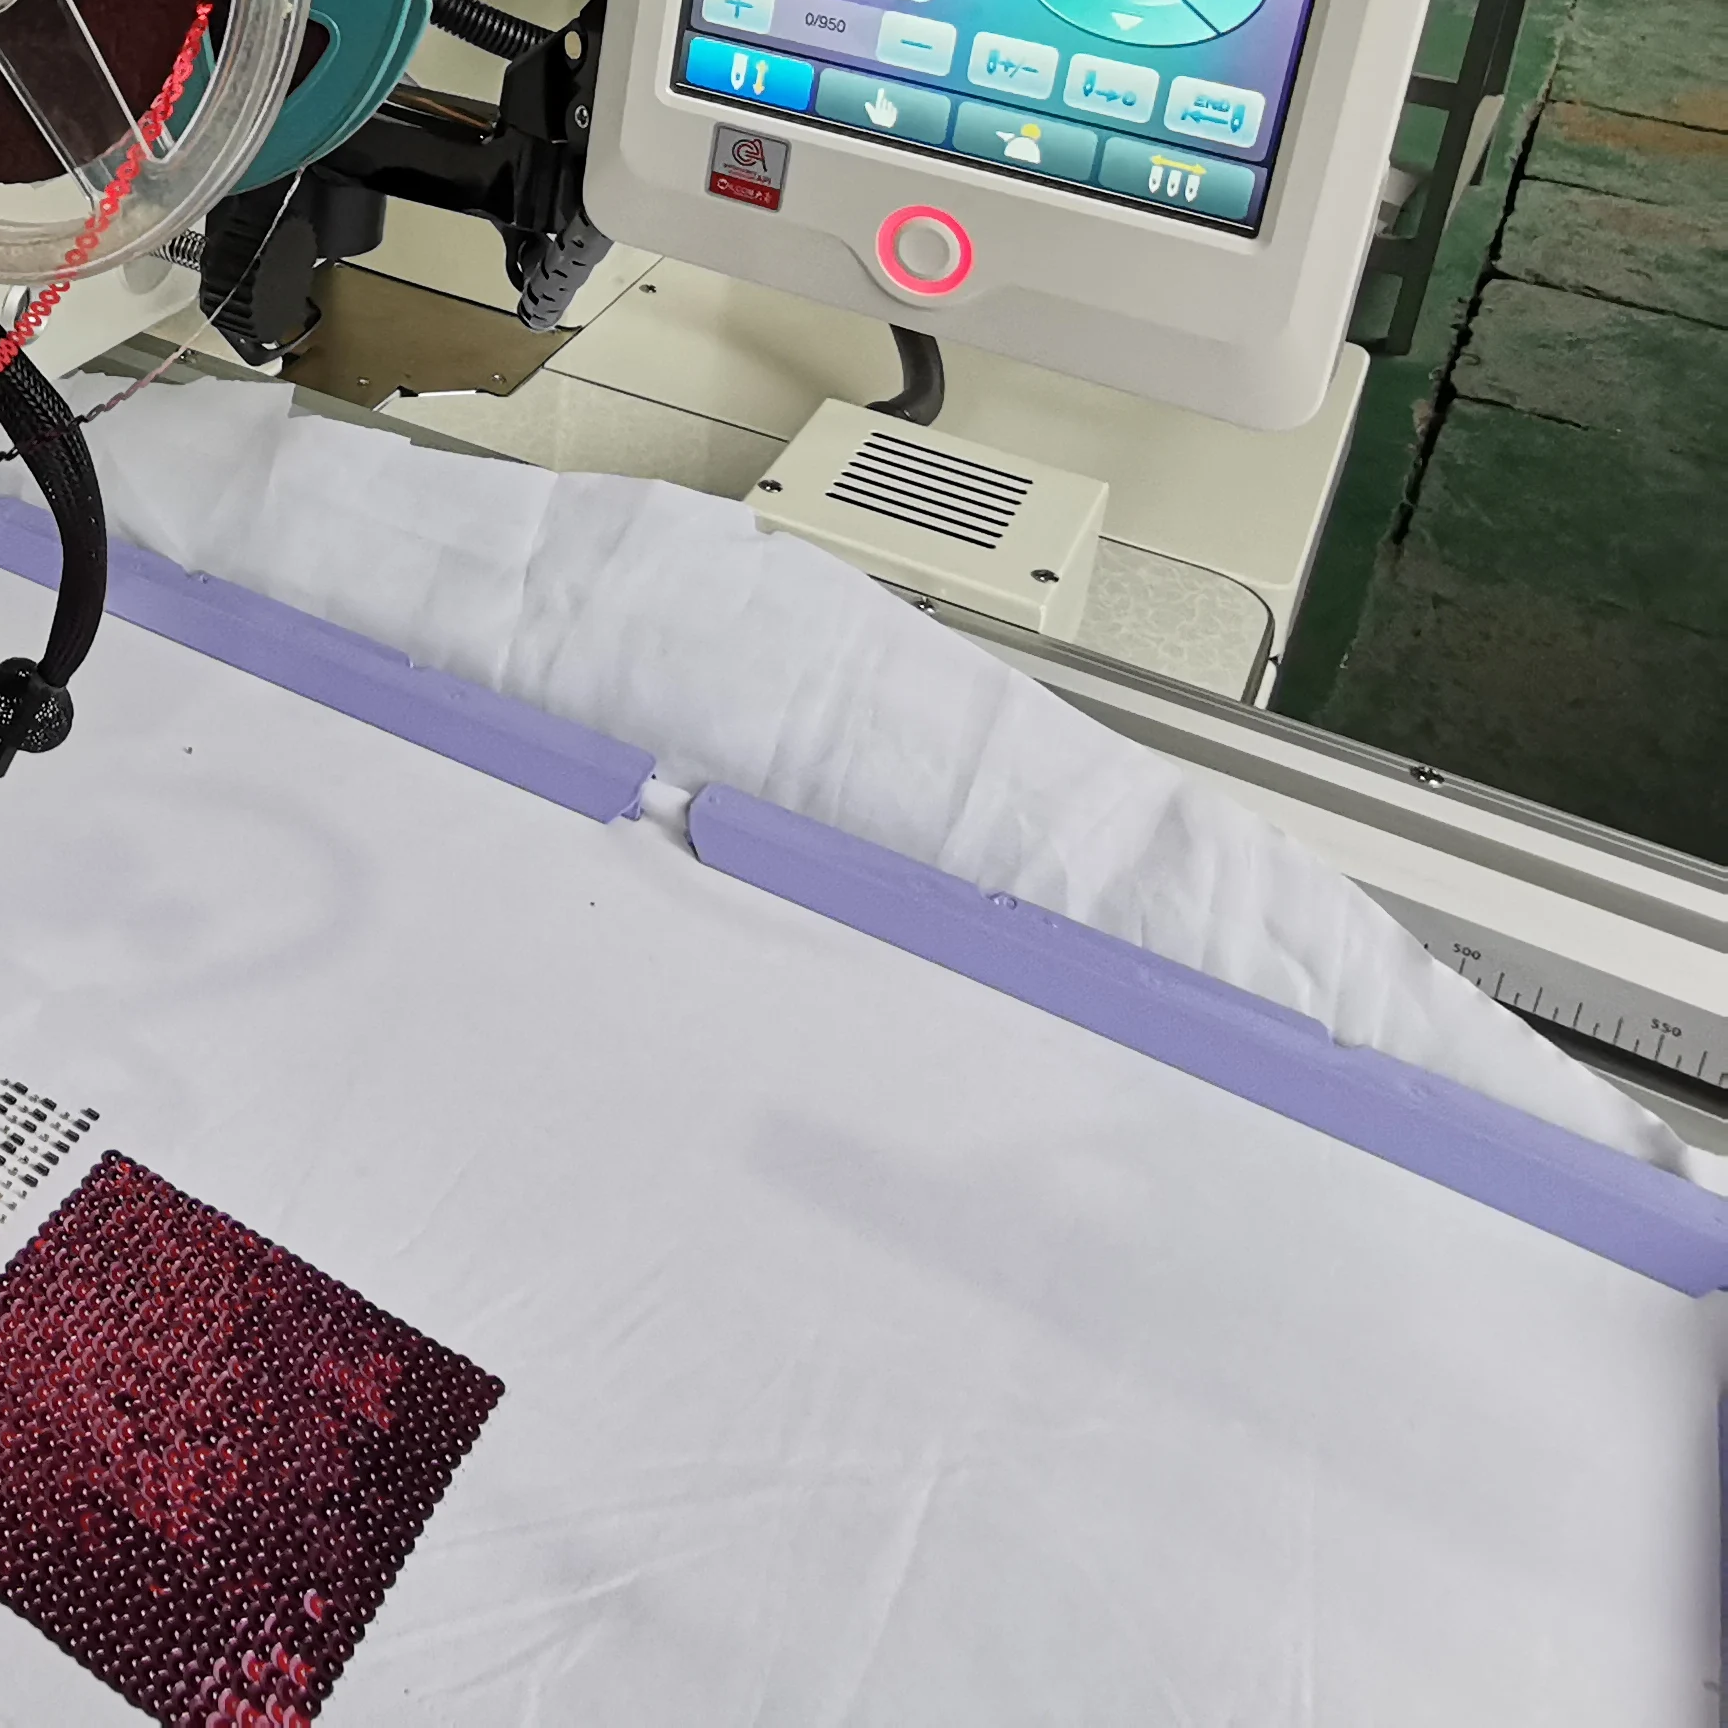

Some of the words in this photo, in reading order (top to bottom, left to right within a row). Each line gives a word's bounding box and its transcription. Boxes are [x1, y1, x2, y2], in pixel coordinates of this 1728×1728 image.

[805, 11, 847, 33] 0/950
[1452, 942, 1482, 962] 500
[1650, 1017, 1683, 1038] 550
